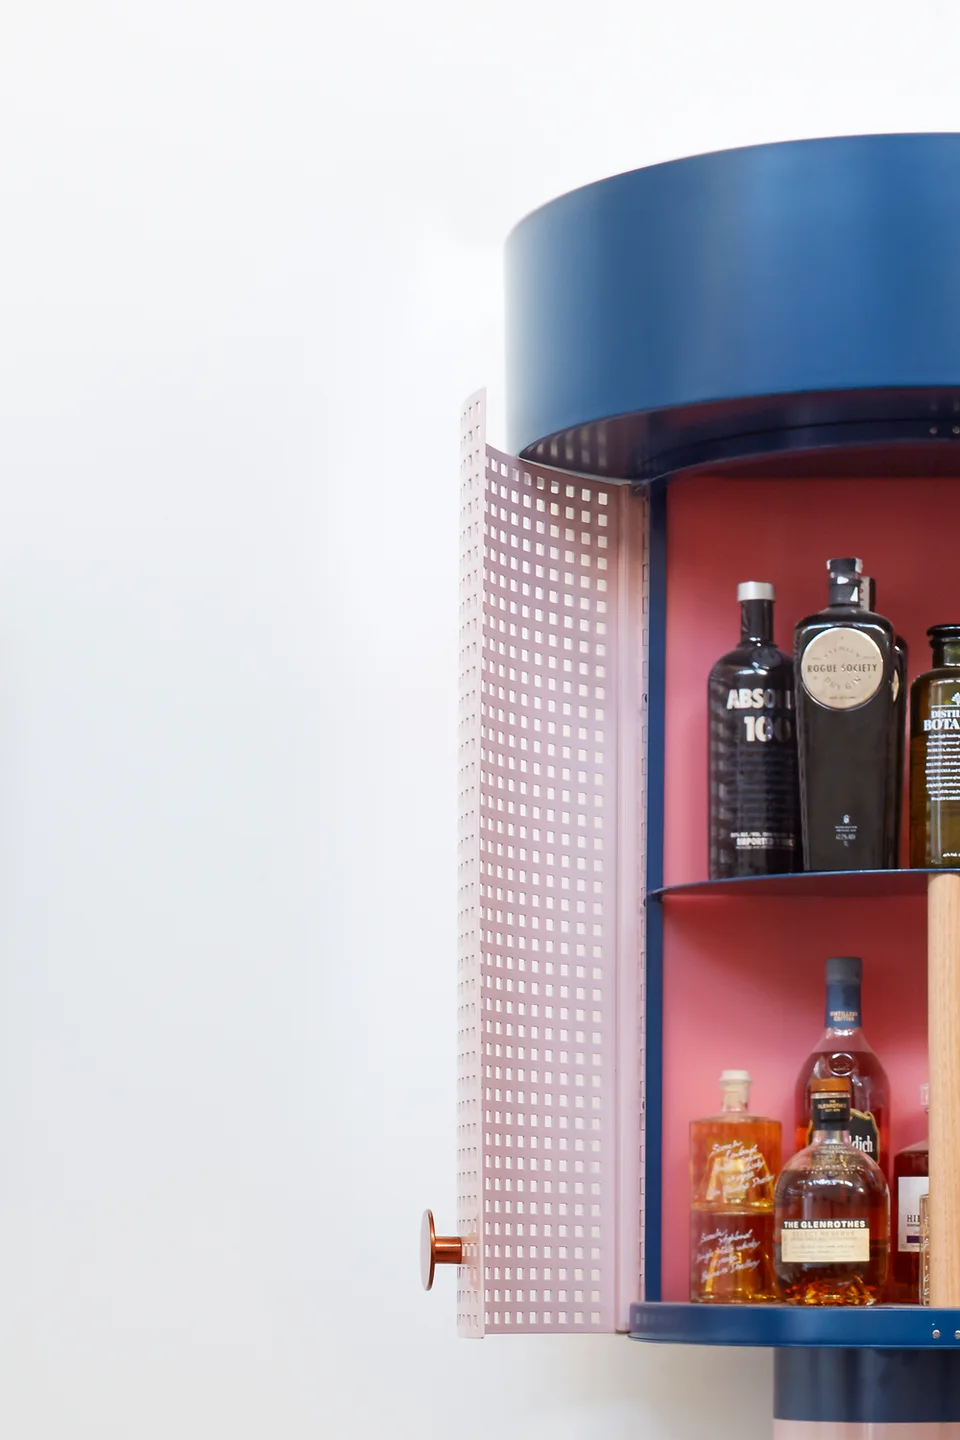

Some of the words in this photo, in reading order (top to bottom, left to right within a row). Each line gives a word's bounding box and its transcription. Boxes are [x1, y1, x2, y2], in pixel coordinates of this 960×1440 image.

[807, 664, 837, 673] ROGUE
[840, 663, 877, 672] SOCIETY
[783, 1221, 799, 1229] THE
[800, 1220, 866, 1229] GLENROTHES
